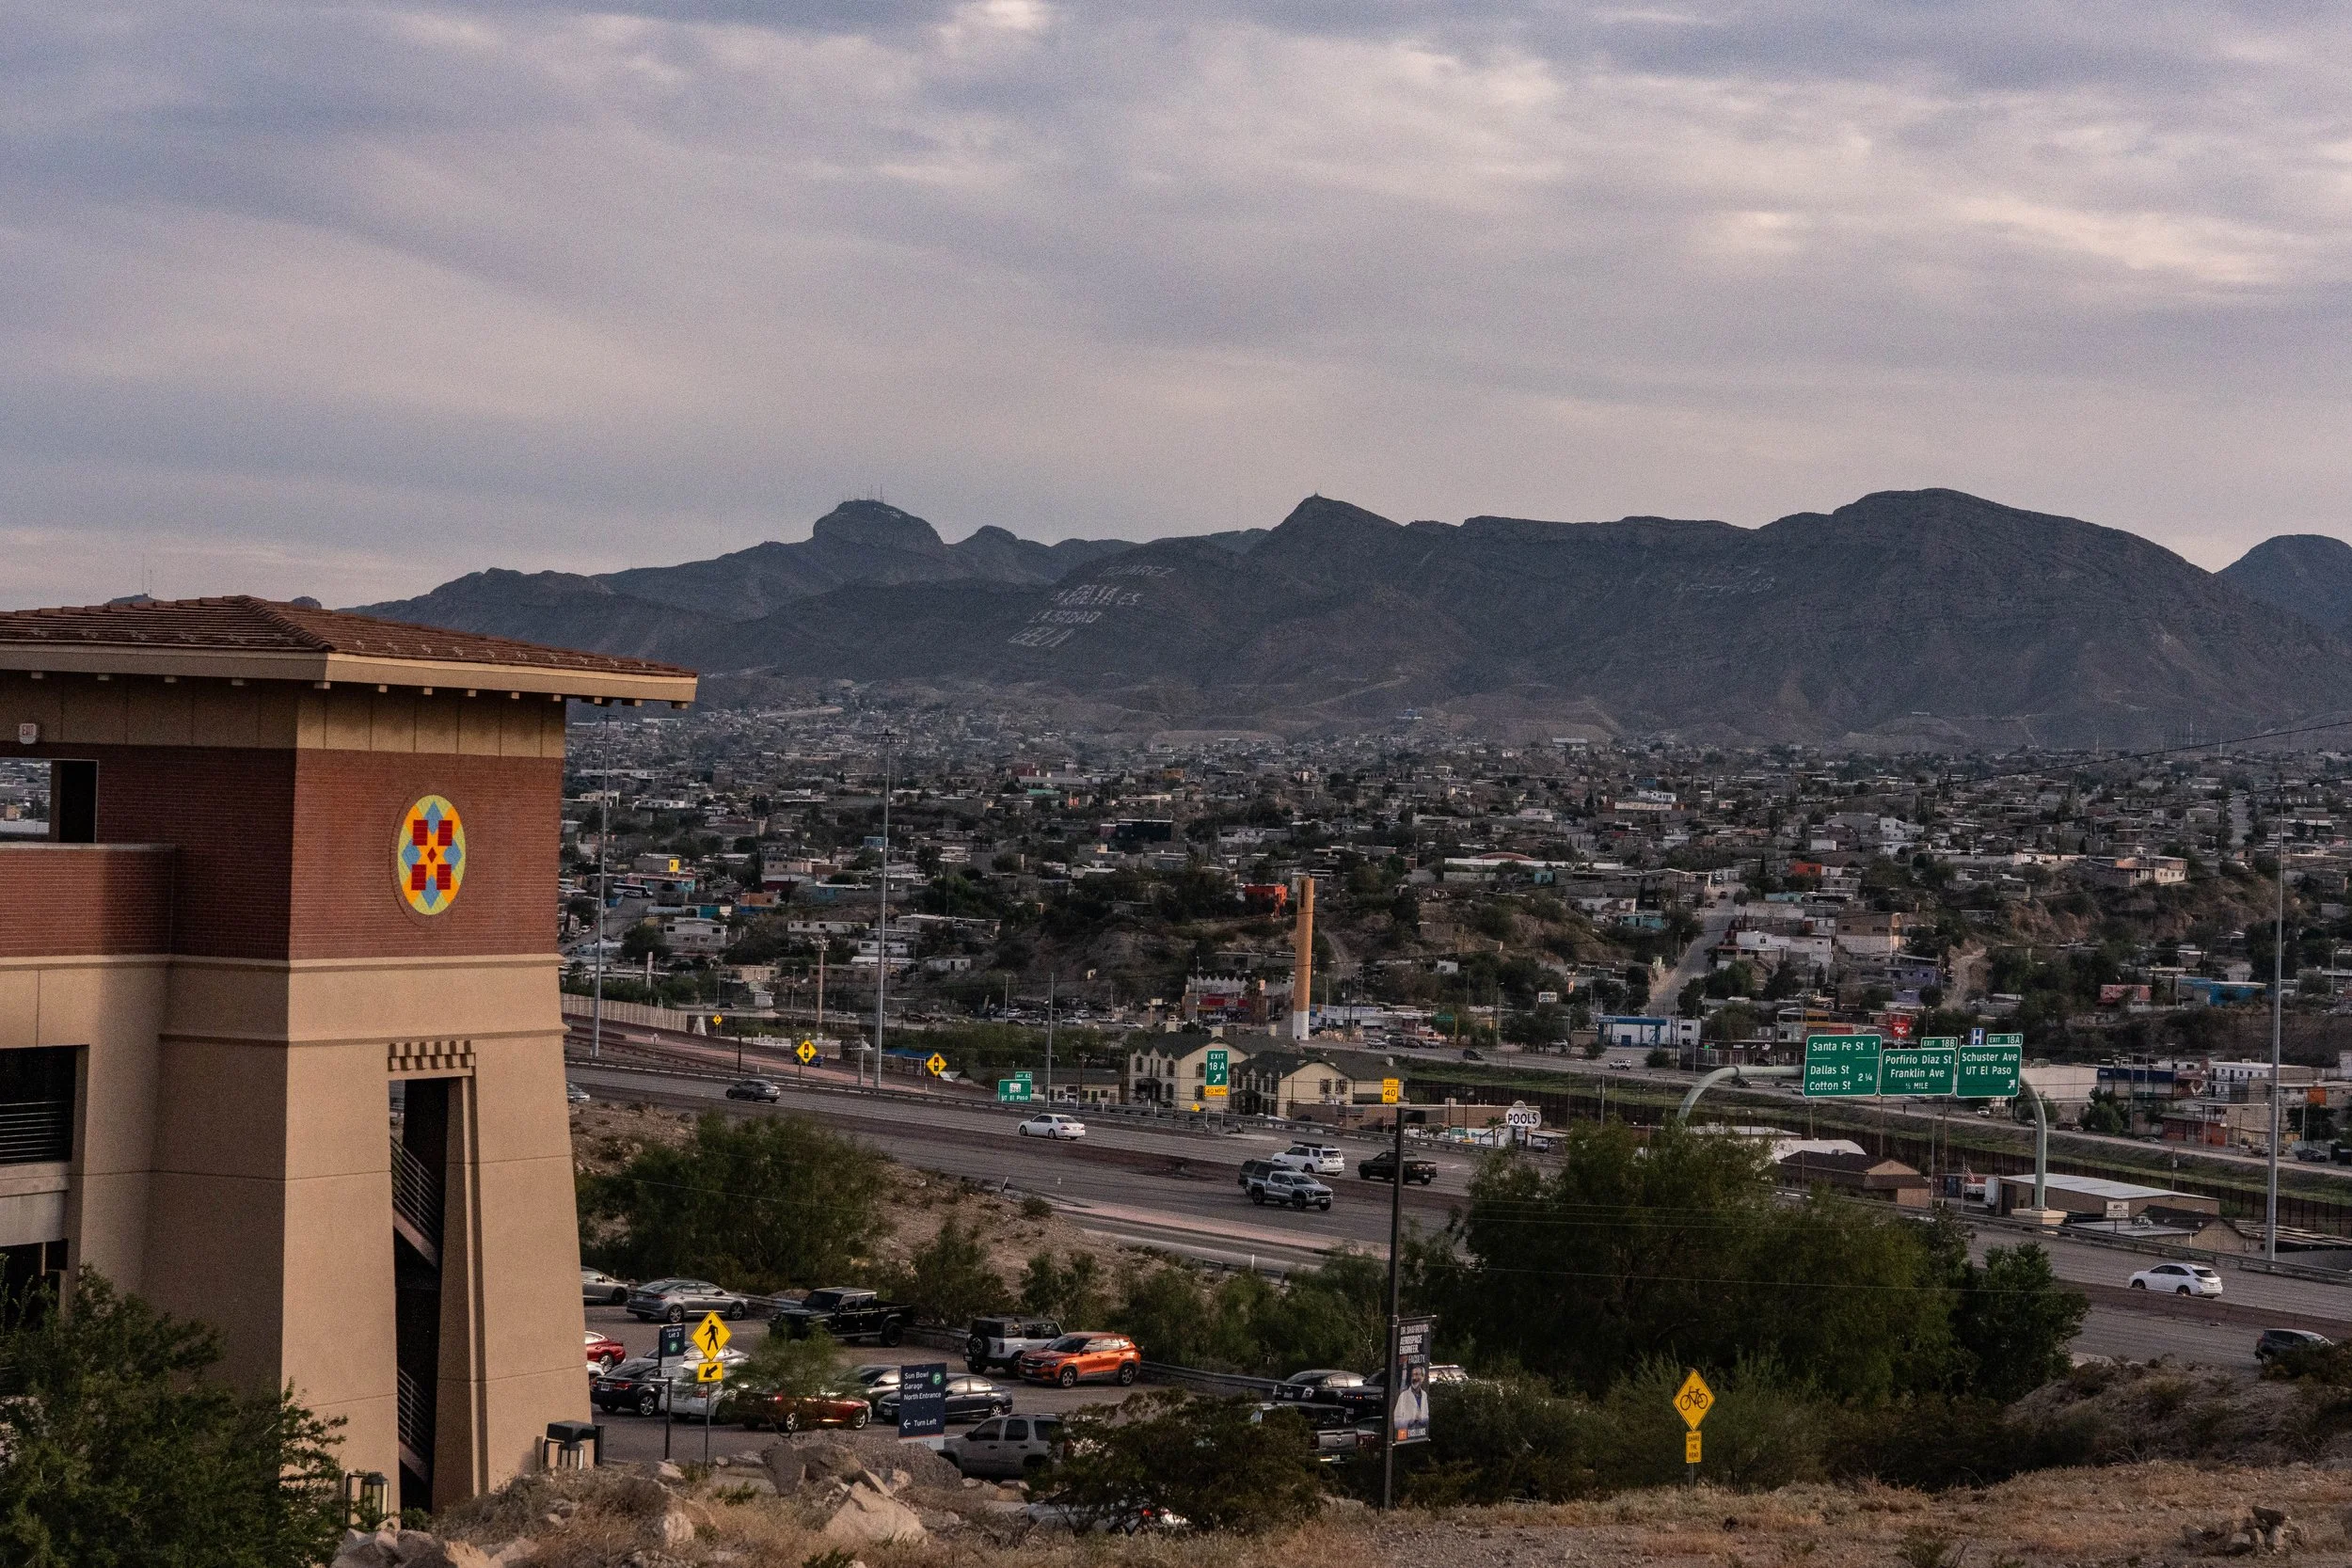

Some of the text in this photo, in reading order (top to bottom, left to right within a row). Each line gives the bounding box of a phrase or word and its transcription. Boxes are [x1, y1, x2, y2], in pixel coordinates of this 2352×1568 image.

[1972, 1029, 1982, 1045] H
[2007, 1036, 2020, 1044] 18A
[1812, 1041, 1876, 1052] Santa Fe St 1
[1942, 1038, 1955, 1048] 18B
[1884, 1053, 1952, 1065] Porfirio Diaz St
[1962, 1052, 2018, 1062] Schuster Ave
[1209, 1061, 1225, 1070] 18 A
[1810, 1065, 1850, 1075] Dallas St
[1965, 1065, 2011, 1075] UT El Paso
[1857, 1072, 1864, 1082] 2
[1890, 1068, 1945, 1078] Franklin Ave
[1809, 1081, 1851, 1091] Cotton St
[1385, 1088, 1396, 1097] 40
[1507, 1113, 1537, 1125] POOLS
[934, 1374, 940, 1384] P
[918, 1391, 942, 1400] Entrance
[926, 1418, 937, 1426] Left
